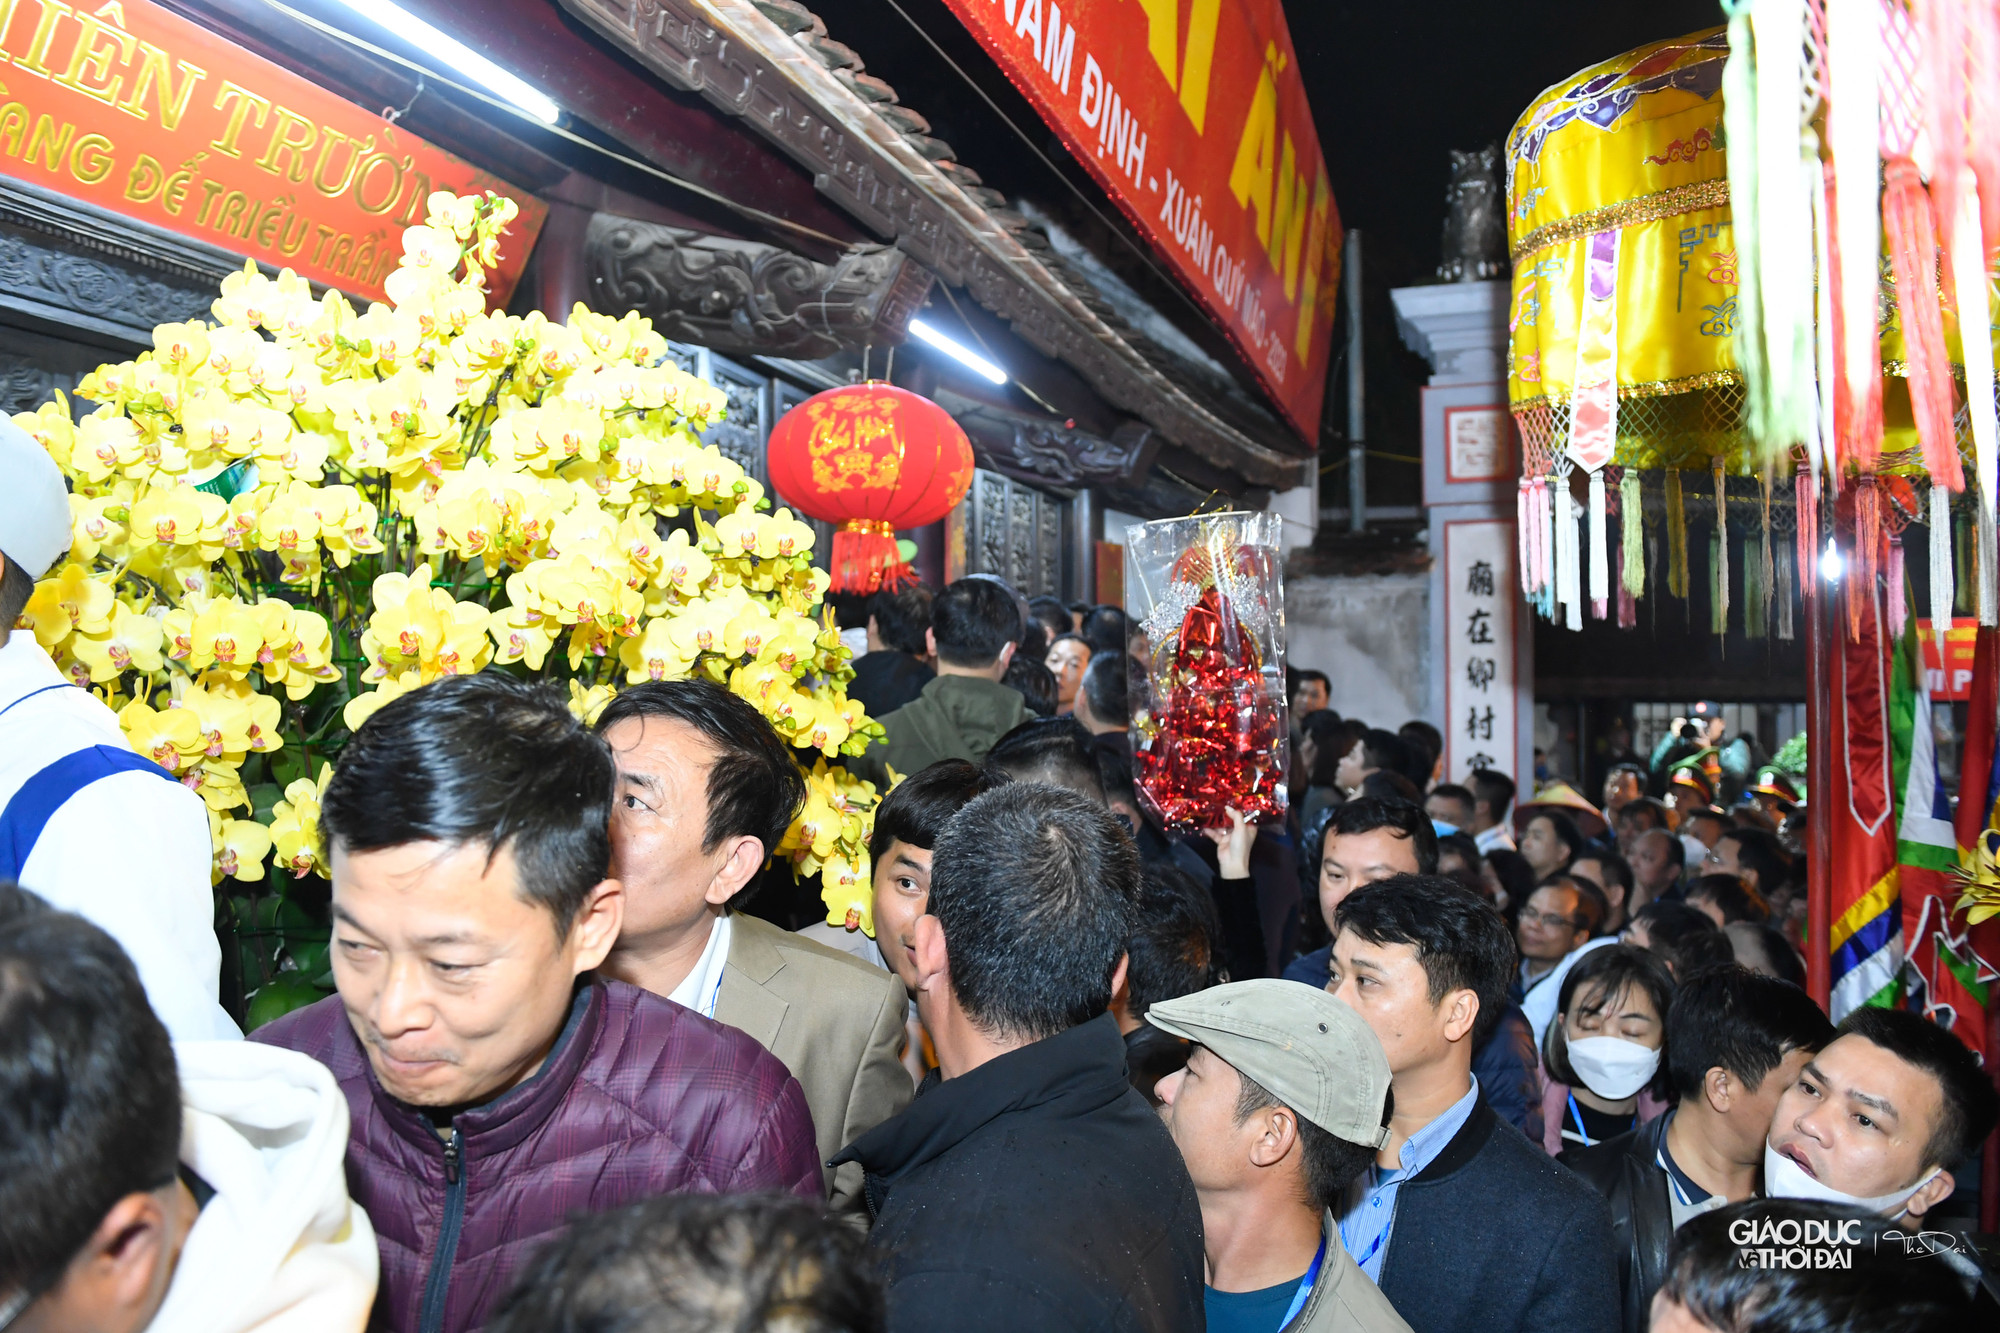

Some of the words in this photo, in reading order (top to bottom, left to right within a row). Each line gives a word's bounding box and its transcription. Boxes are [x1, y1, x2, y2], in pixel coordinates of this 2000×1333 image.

[0, 0, 208, 131] IÊN
[209, 80, 457, 229] TRƯỜN
[124, 151, 211, 216] ĐẾ
[195, 179, 309, 257] TRIỀU
[1079, 52, 1147, 190] ĐỊNH
[1159, 167, 1213, 275] XUÂN
